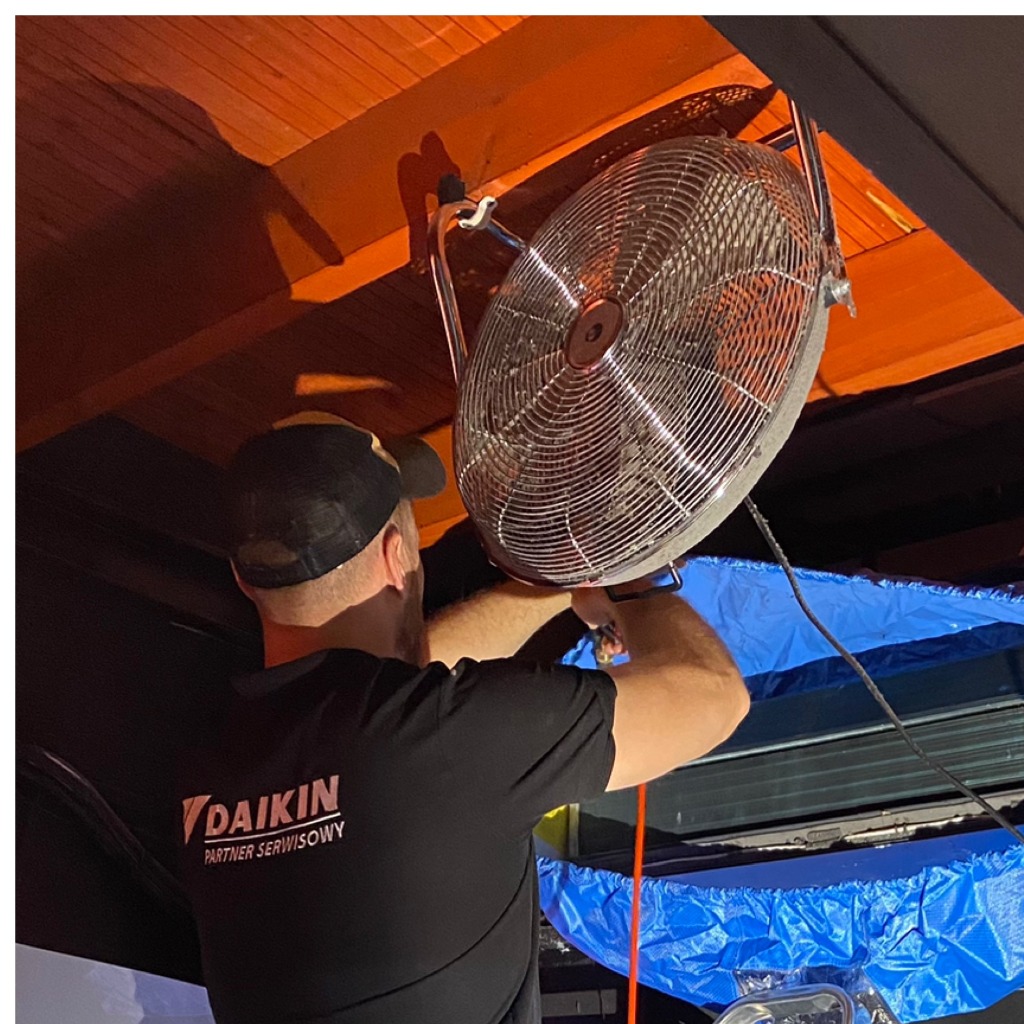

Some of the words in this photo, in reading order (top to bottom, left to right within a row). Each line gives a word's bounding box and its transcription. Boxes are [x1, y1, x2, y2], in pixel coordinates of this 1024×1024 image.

[205, 774, 340, 836] DAIKIN
[204, 843, 255, 865] PARTNER
[256, 821, 346, 858] SERWISOWY
